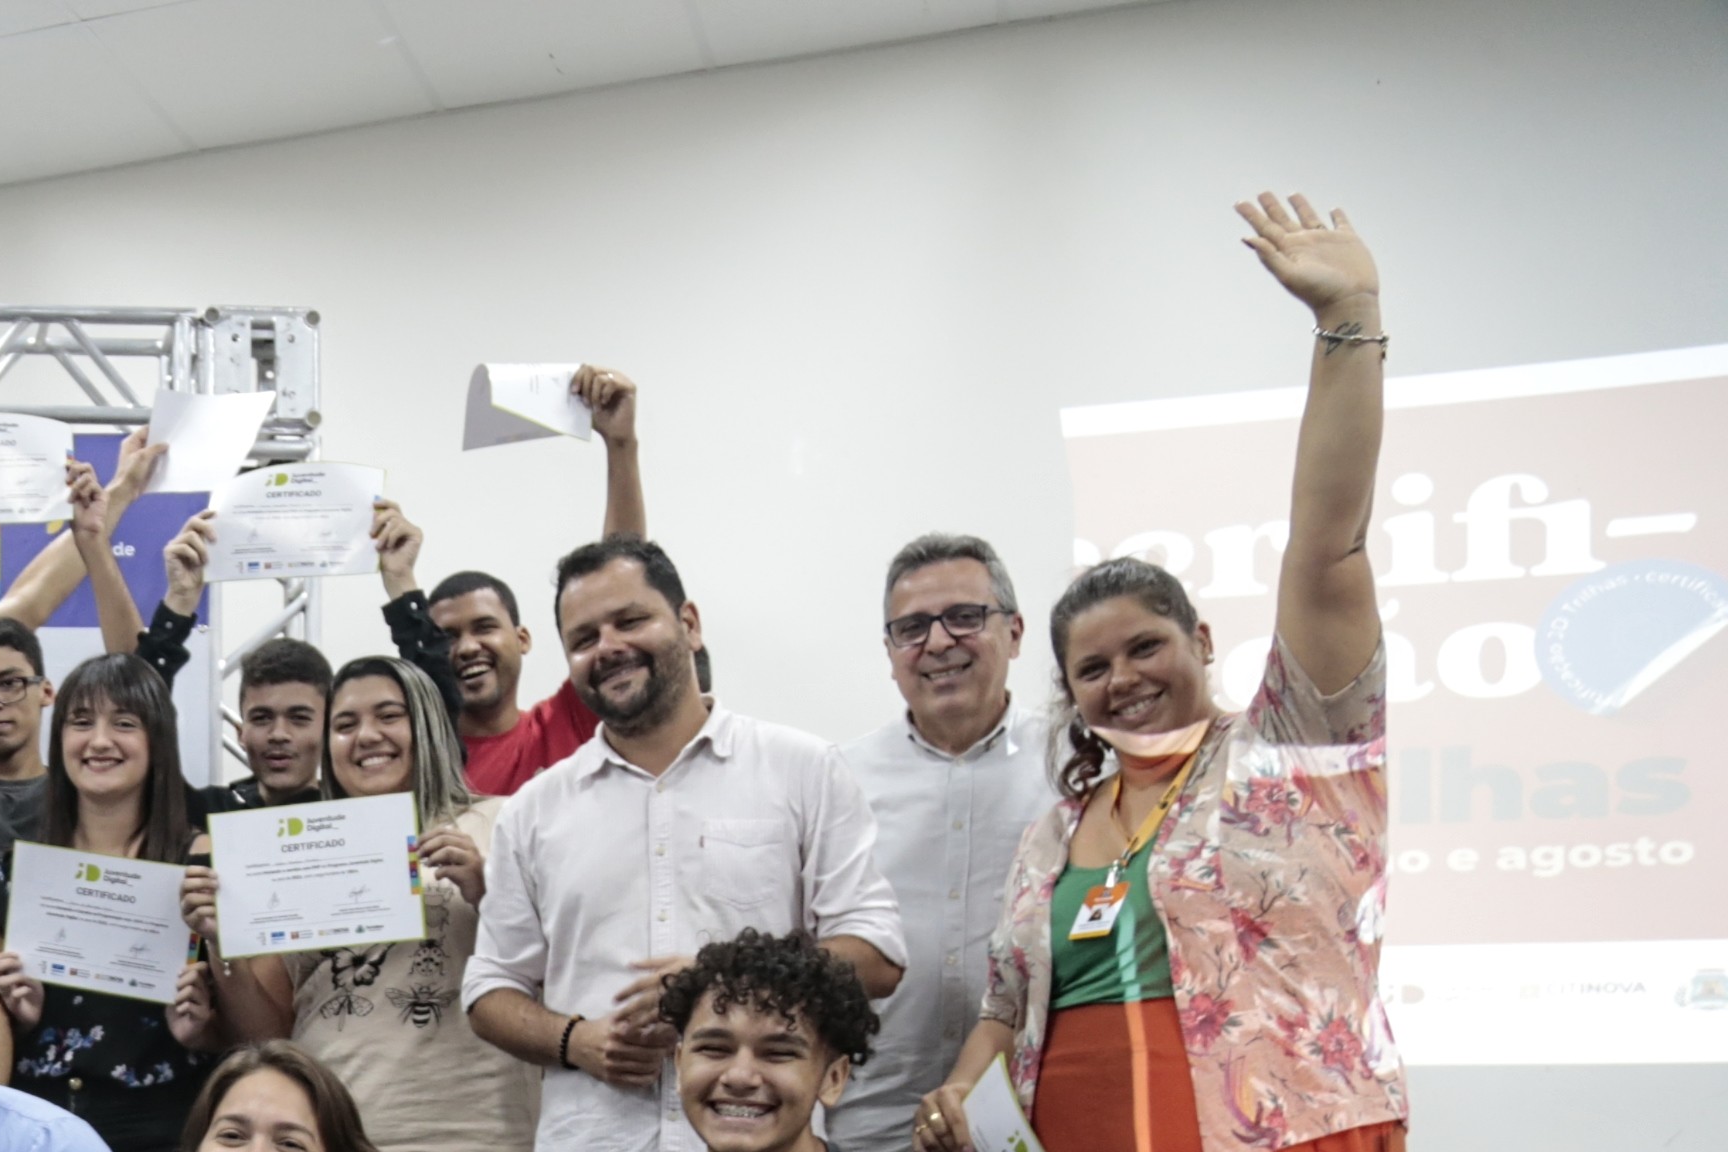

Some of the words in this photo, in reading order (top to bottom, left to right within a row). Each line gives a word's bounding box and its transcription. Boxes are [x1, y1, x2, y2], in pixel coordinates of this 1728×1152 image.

[266, 490, 322, 498] CERTIFICADO
[306, 813, 346, 824] Juventude
[281, 838, 345, 853] CERTIFICADO
[1447, 848, 1480, 872] e
[1496, 836, 1695, 878] agosto
[103, 868, 142, 880] Juventude
[75, 887, 136, 904] CERTIFICADO
